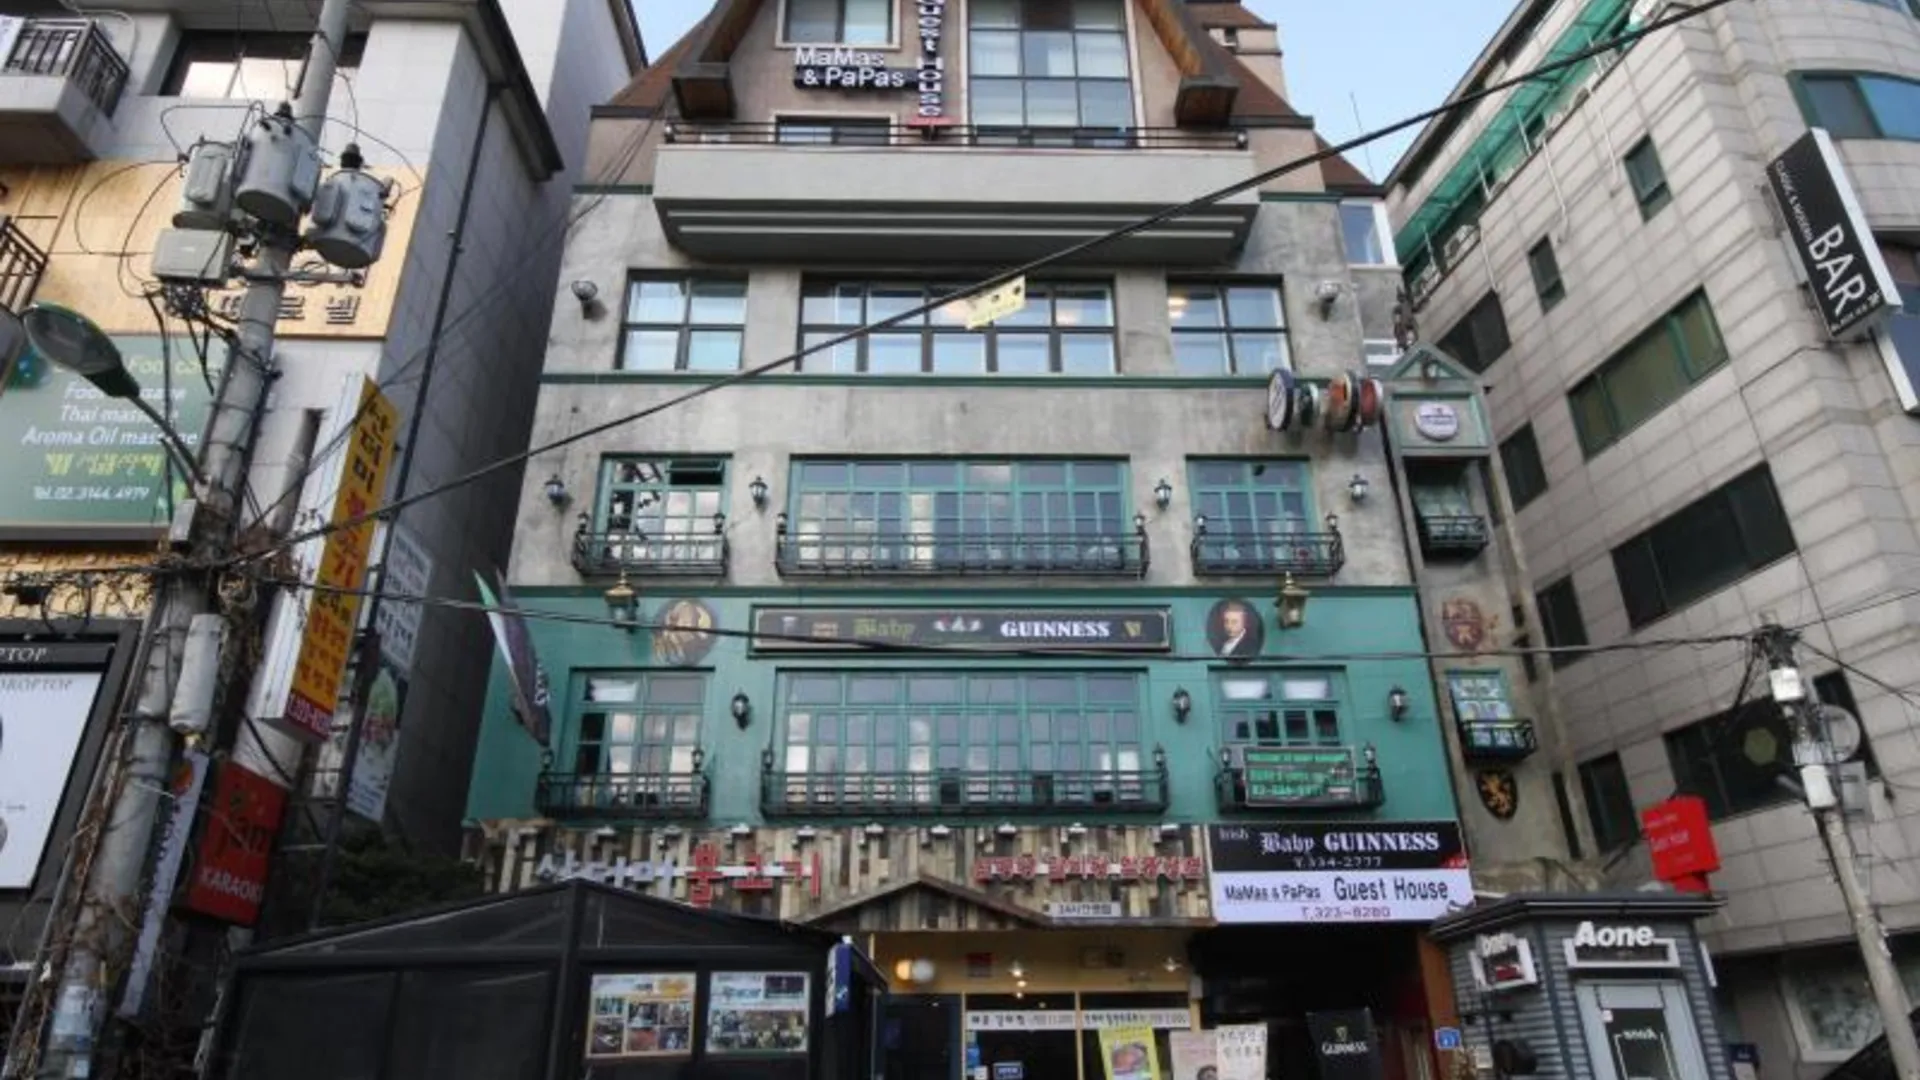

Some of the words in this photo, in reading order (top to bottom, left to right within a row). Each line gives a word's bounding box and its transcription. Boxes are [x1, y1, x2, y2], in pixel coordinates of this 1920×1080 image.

[796, 47, 884, 66] MaMas
[803, 68, 819, 86] &
[825, 67, 905, 87] PaPas
[916, 57, 944, 116] House
[1809, 223, 1866, 316] BAR
[21, 426, 84, 446] Aroma
[89, 426, 119, 445] Oil
[1001, 619, 1111, 638] GUINNESS
[1219, 827, 1249, 841] Irish
[1259, 831, 1316, 855] Baby
[1323, 831, 1440, 851] GUINNESS
[1333, 876, 1388, 901] Guest
[1394, 877, 1449, 901] House
[1574, 921, 1655, 948] Aone
